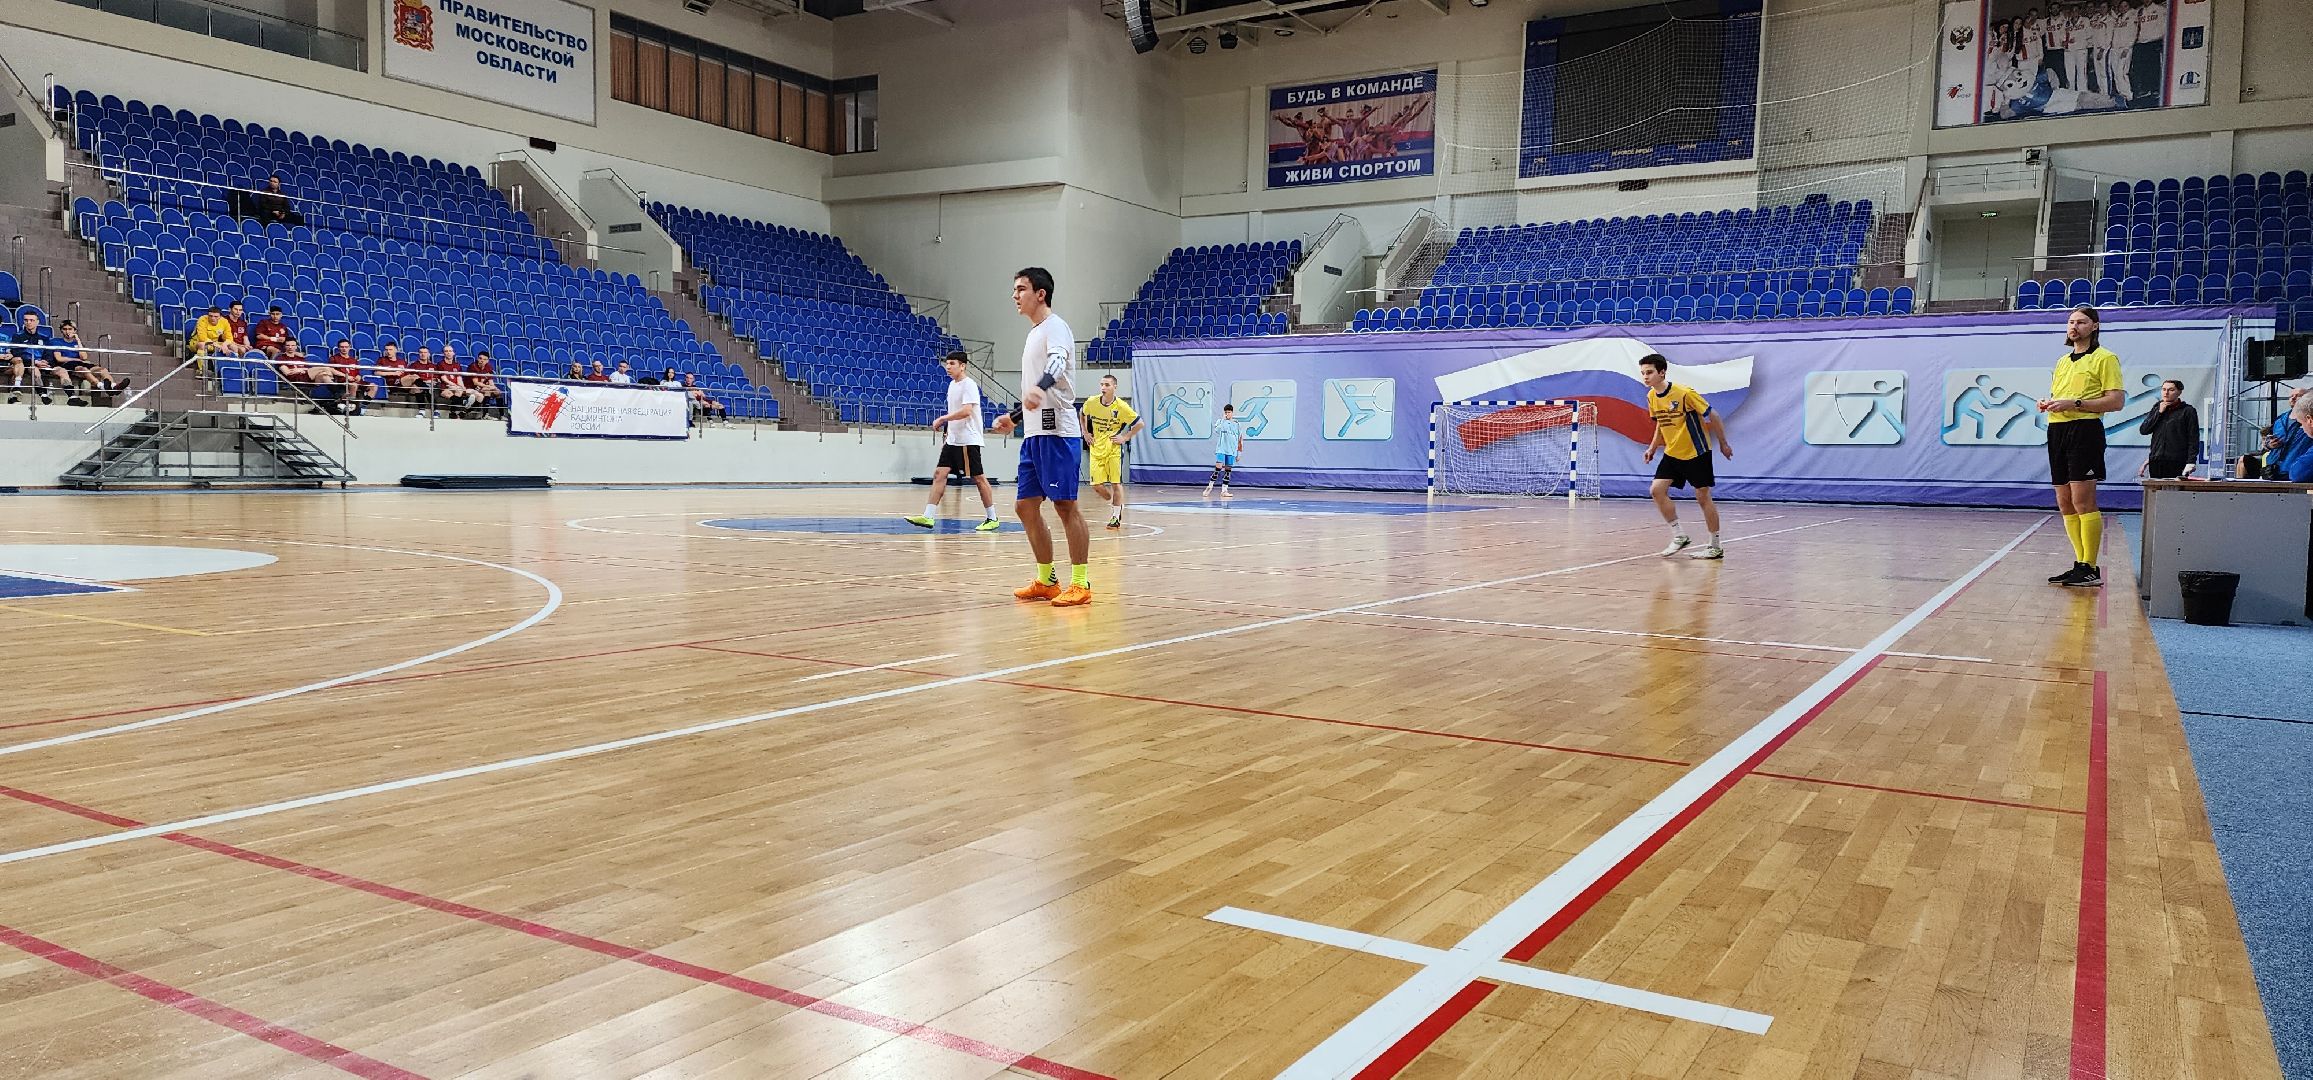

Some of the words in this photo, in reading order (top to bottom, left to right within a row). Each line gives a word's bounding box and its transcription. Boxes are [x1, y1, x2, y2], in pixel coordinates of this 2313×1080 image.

[440, 0, 588, 52] ПРАВИТЕЛЬСТВО
[456, 22, 575, 68] МОСКОВСКОЙ
[476, 50, 558, 83] ОБЛАСТИ
[1287, 90, 1326, 104] БУДЬ
[1331, 86, 1341, 99] В
[1346, 76, 1424, 97] КОМАНДЕ
[1285, 165, 1333, 183] ЖИВИ
[1338, 158, 1421, 179] СПОРТОМ
